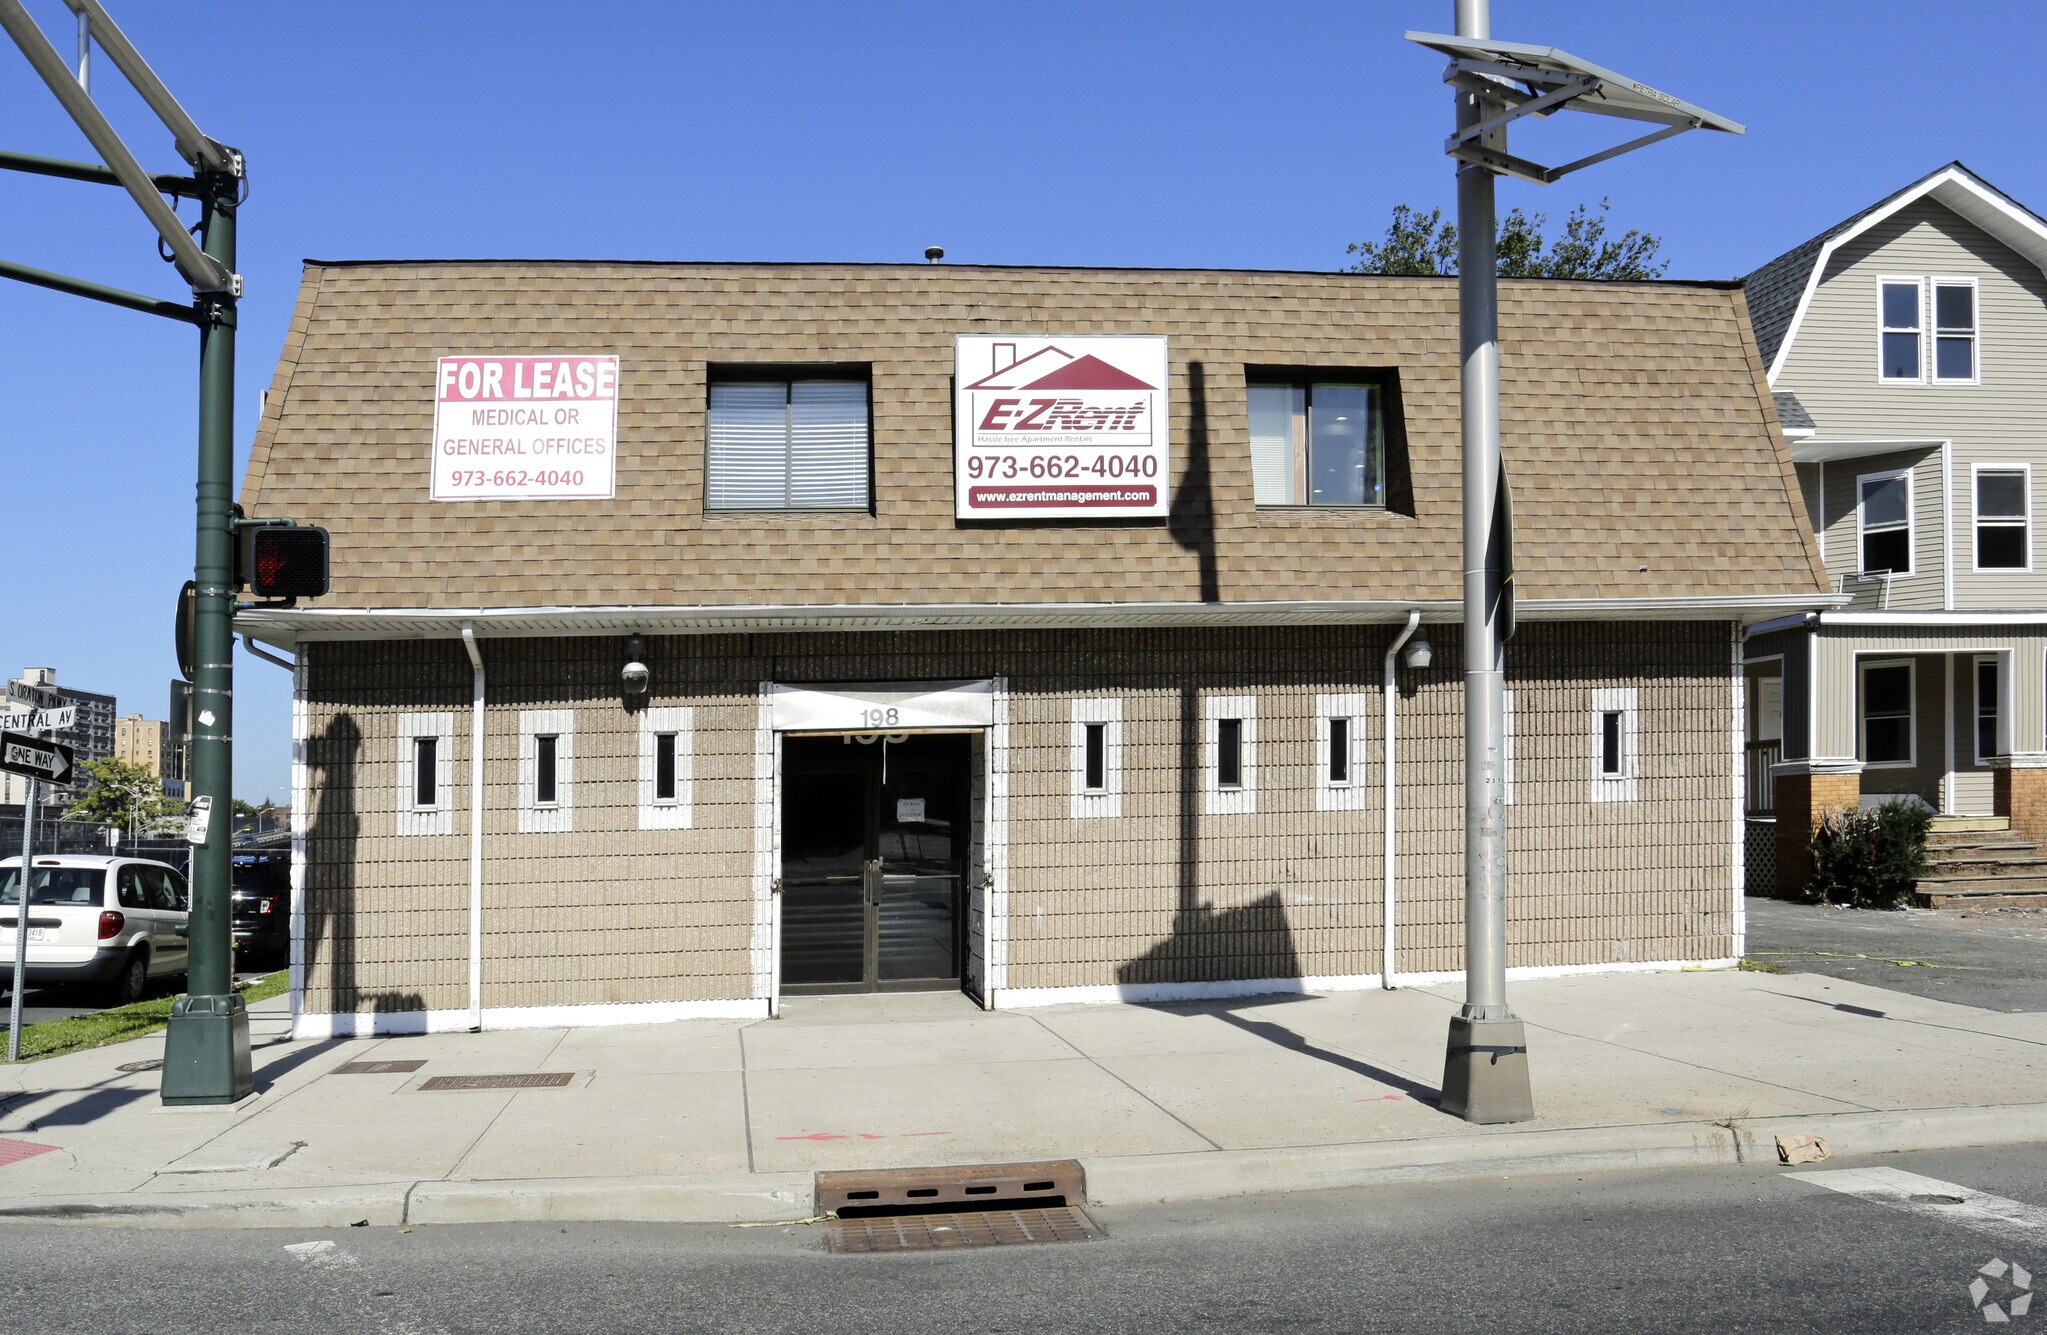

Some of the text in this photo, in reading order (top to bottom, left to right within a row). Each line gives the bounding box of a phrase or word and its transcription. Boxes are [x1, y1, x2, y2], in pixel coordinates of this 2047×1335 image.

[1637, 84, 1681, 106] PETRA SOLAR
[439, 361, 617, 399] FOR LEASE
[471, 408, 580, 426] MEDICAL OR
[443, 437, 606, 456] GENERAL OFFICES
[977, 435, 1093, 444] Hassle free Apartment Rentals
[967, 455, 1158, 479] 973-662-4040
[451, 470, 584, 487] 973-662-4040
[976, 490, 1150, 504] www.ezrentmanagement.com
[9, 681, 68, 707] S. ORATON PKWY
[58, 710, 72, 725] AV
[860, 707, 900, 728] 198
[11, 745, 55, 768] ONE WAY
